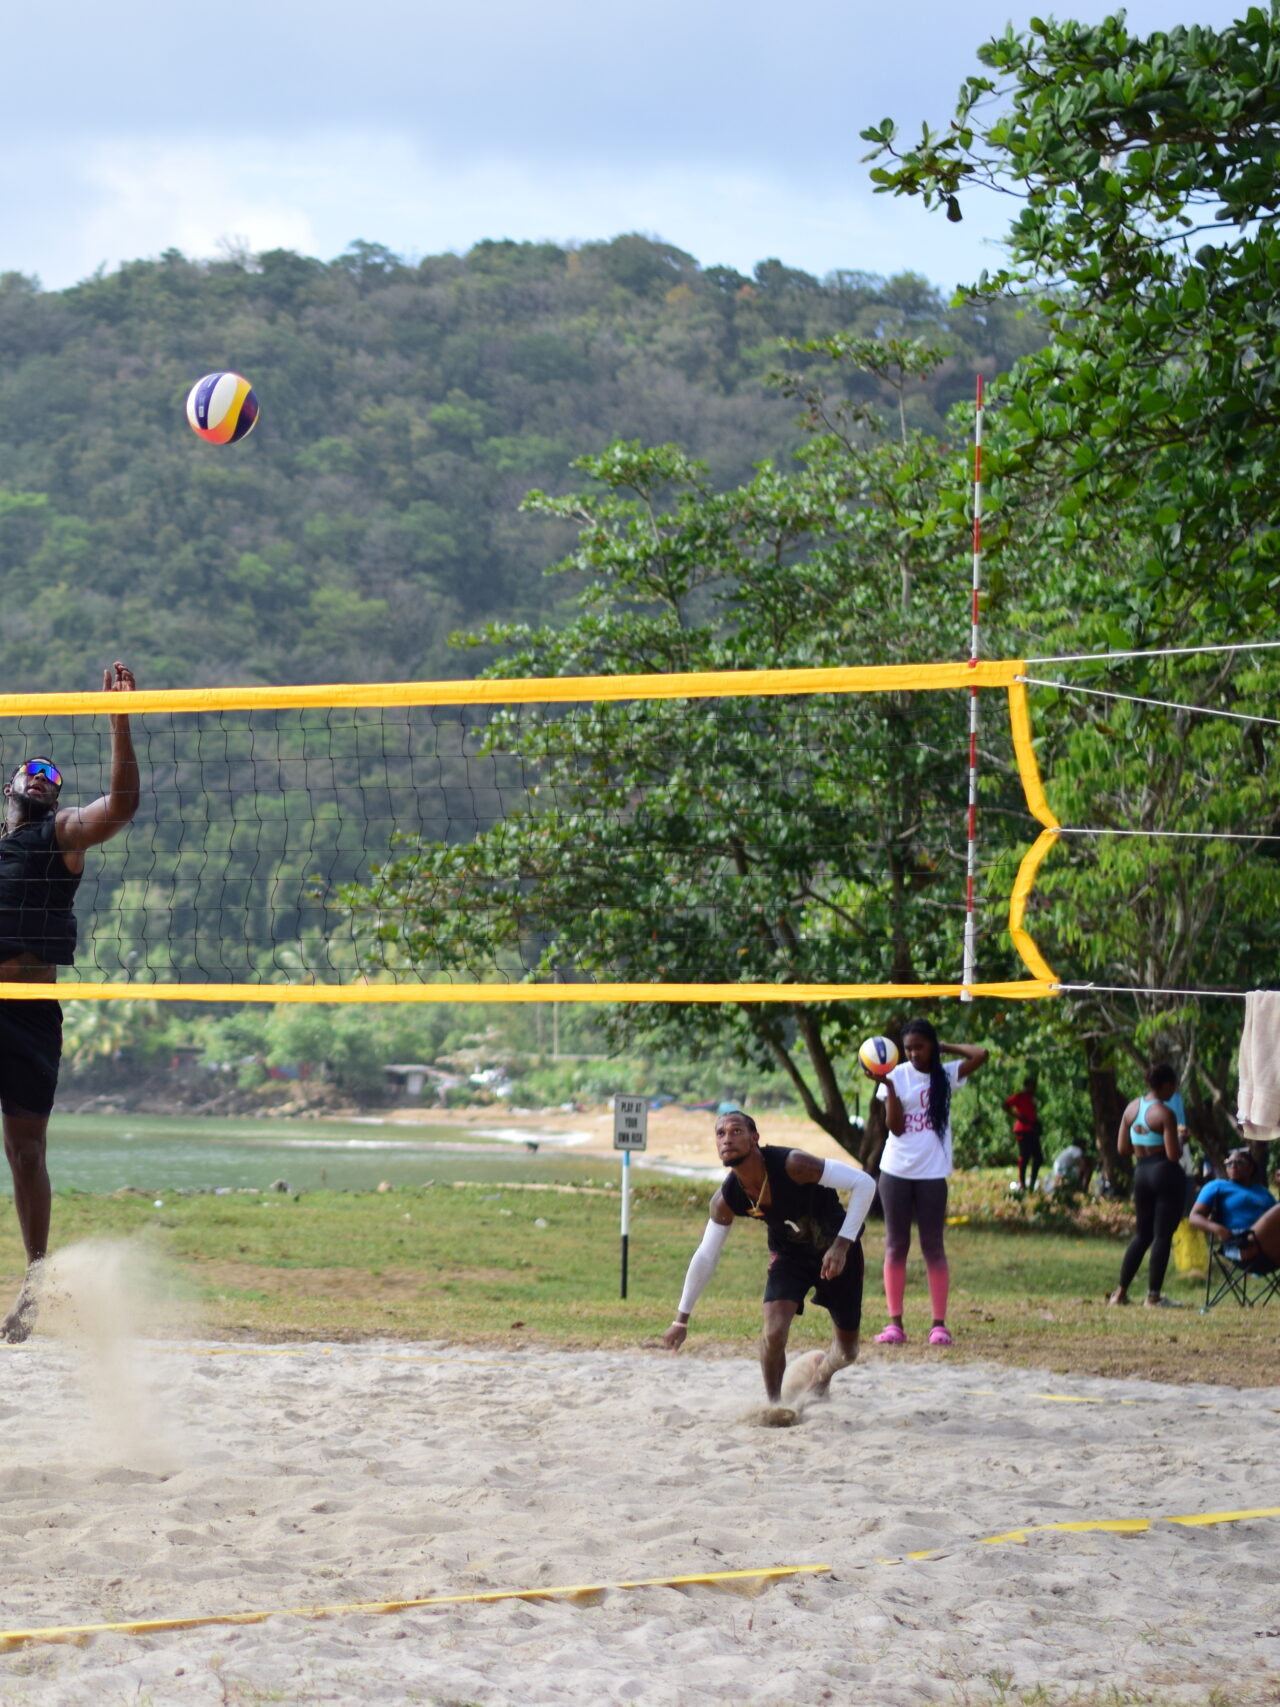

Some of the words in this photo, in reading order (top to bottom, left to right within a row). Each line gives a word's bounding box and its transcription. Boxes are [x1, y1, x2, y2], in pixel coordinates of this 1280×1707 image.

[621, 1101, 634, 1113] PLAY
[635, 1102, 642, 1113] AT
[625, 1117, 637, 1128] YOUR
[618, 1132, 629, 1143] OWN
[631, 1132, 642, 1143] RISK
